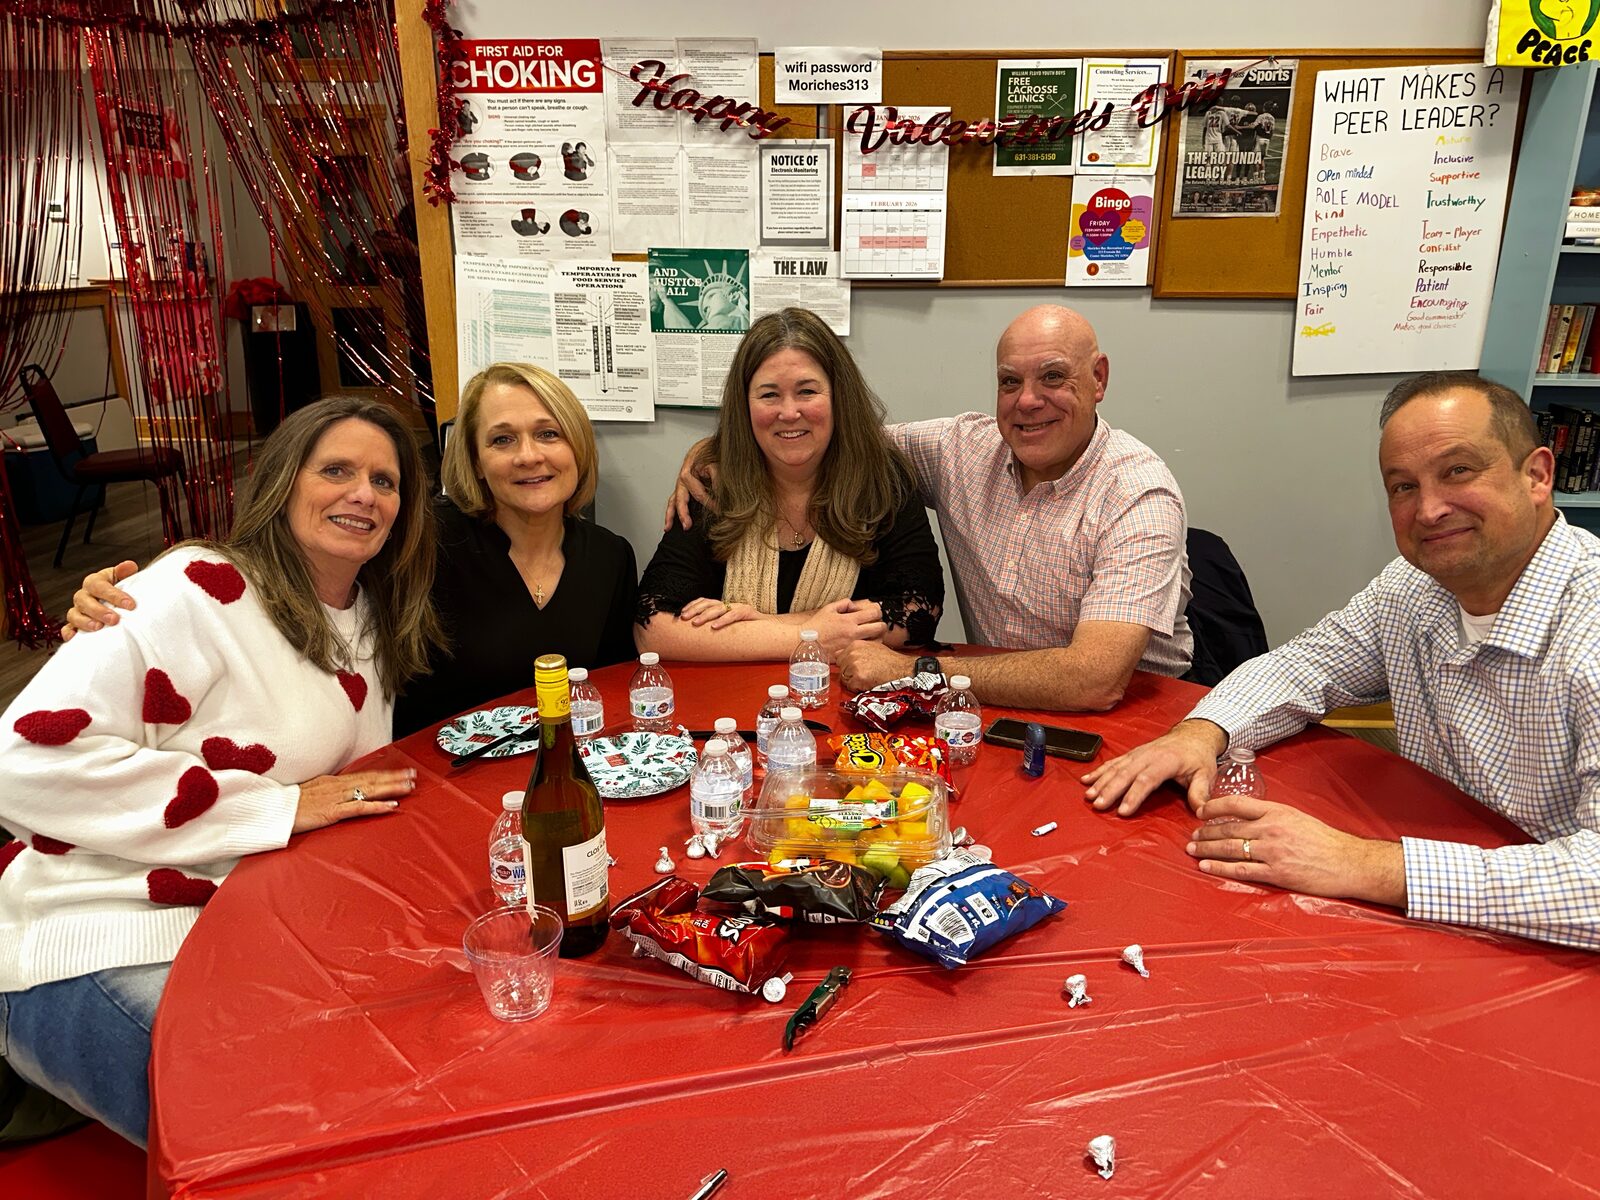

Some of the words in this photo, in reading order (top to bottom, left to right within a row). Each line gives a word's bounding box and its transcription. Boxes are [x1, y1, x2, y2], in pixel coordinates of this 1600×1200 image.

[476, 46, 508, 56] FIRST
[512, 46, 534, 56] AID
[538, 46, 564, 56] FOR
[1516, 28, 1592, 66] PEACE
[452, 59, 596, 88] CHOKING
[785, 61, 806, 73] wifi
[811, 61, 872, 76] password
[1008, 77, 1030, 85] FREE
[1248, 68, 1290, 84] Sports
[788, 79, 868, 90] Moriches313
[1008, 86, 1058, 94] LACROSSE
[1324, 78, 1385, 103] WHAT
[1400, 72, 1476, 100] MAKES
[1486, 68, 1504, 94] A
[630, 60, 791, 139] Happy
[1008, 94, 1045, 102] CLINICS
[1131, 68, 1232, 128] Day
[1334, 110, 1388, 134] PEER
[1402, 104, 1500, 130] LEADER?
[1188, 152, 1207, 165] THE
[1208, 152, 1262, 165] ROTUNDA
[1321, 144, 1352, 161] Brave
[1434, 151, 1474, 164] Inclusive
[771, 156, 804, 166] NOTICE
[806, 156, 818, 166] OF
[1186, 166, 1227, 179] LEGACY
[1345, 165, 1374, 178] minded
[1430, 171, 1480, 184] Supportive
[1095, 196, 1131, 210] Bingo
[1316, 187, 1348, 205] ROLE
[1357, 192, 1399, 209] MODEL
[1427, 190, 1486, 212] Trustworthy
[1311, 248, 1352, 260] Humble
[654, 268, 678, 276] AND
[774, 261, 796, 276] THE
[800, 261, 828, 276] LAW
[1308, 262, 1343, 280] Mentor
[1419, 259, 1472, 276] Responsible
[654, 278, 702, 287] JUSTICE
[1416, 278, 1449, 292] Patient
[667, 287, 688, 296] ALL
[1303, 283, 1347, 298] Inspiring
[1305, 303, 1324, 316] Fair
[1410, 296, 1469, 310] Encouraging
[1407, 311, 1425, 321] Good
[587, 846, 599, 857] CLOS
